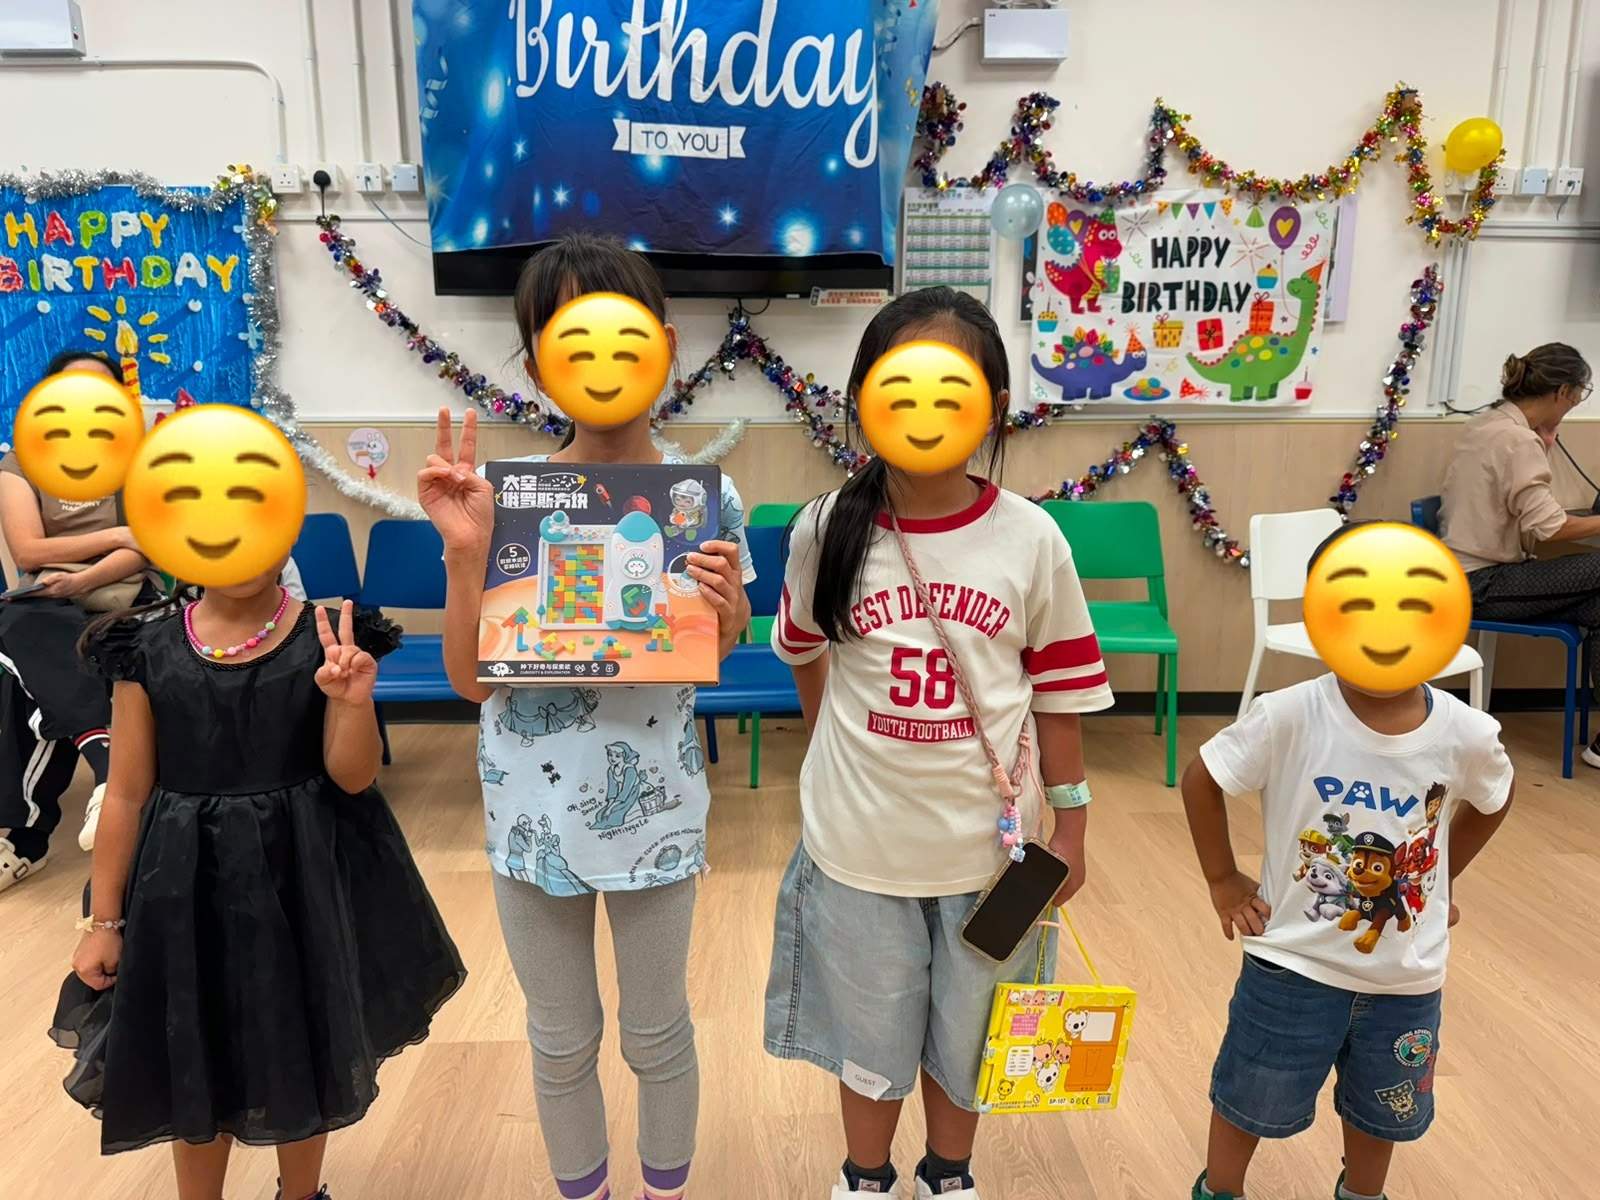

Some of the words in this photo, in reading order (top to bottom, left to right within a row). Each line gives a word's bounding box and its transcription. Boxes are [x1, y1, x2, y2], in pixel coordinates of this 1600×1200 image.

[508, 0, 880, 169] Birthday
[641, 130, 668, 149] TO
[679, 131, 720, 152] YOU
[4, 211, 169, 249] HAPPY
[1151, 236, 1231, 269] HAPPY
[0, 252, 240, 293] BIRTHDAY
[1121, 279, 1252, 314] BIRTHDAY
[502, 474, 538, 491] 太空
[509, 546, 518, 558] 5
[850, 590, 893, 636] EST
[896, 581, 1011, 641] DEFENDER
[889, 646, 957, 710] 58
[871, 712, 907, 737] YOUTH
[909, 721, 972, 740] FOOTBALL
[1313, 776, 1419, 817] PAW
[855, 1073, 877, 1086] GUEST
